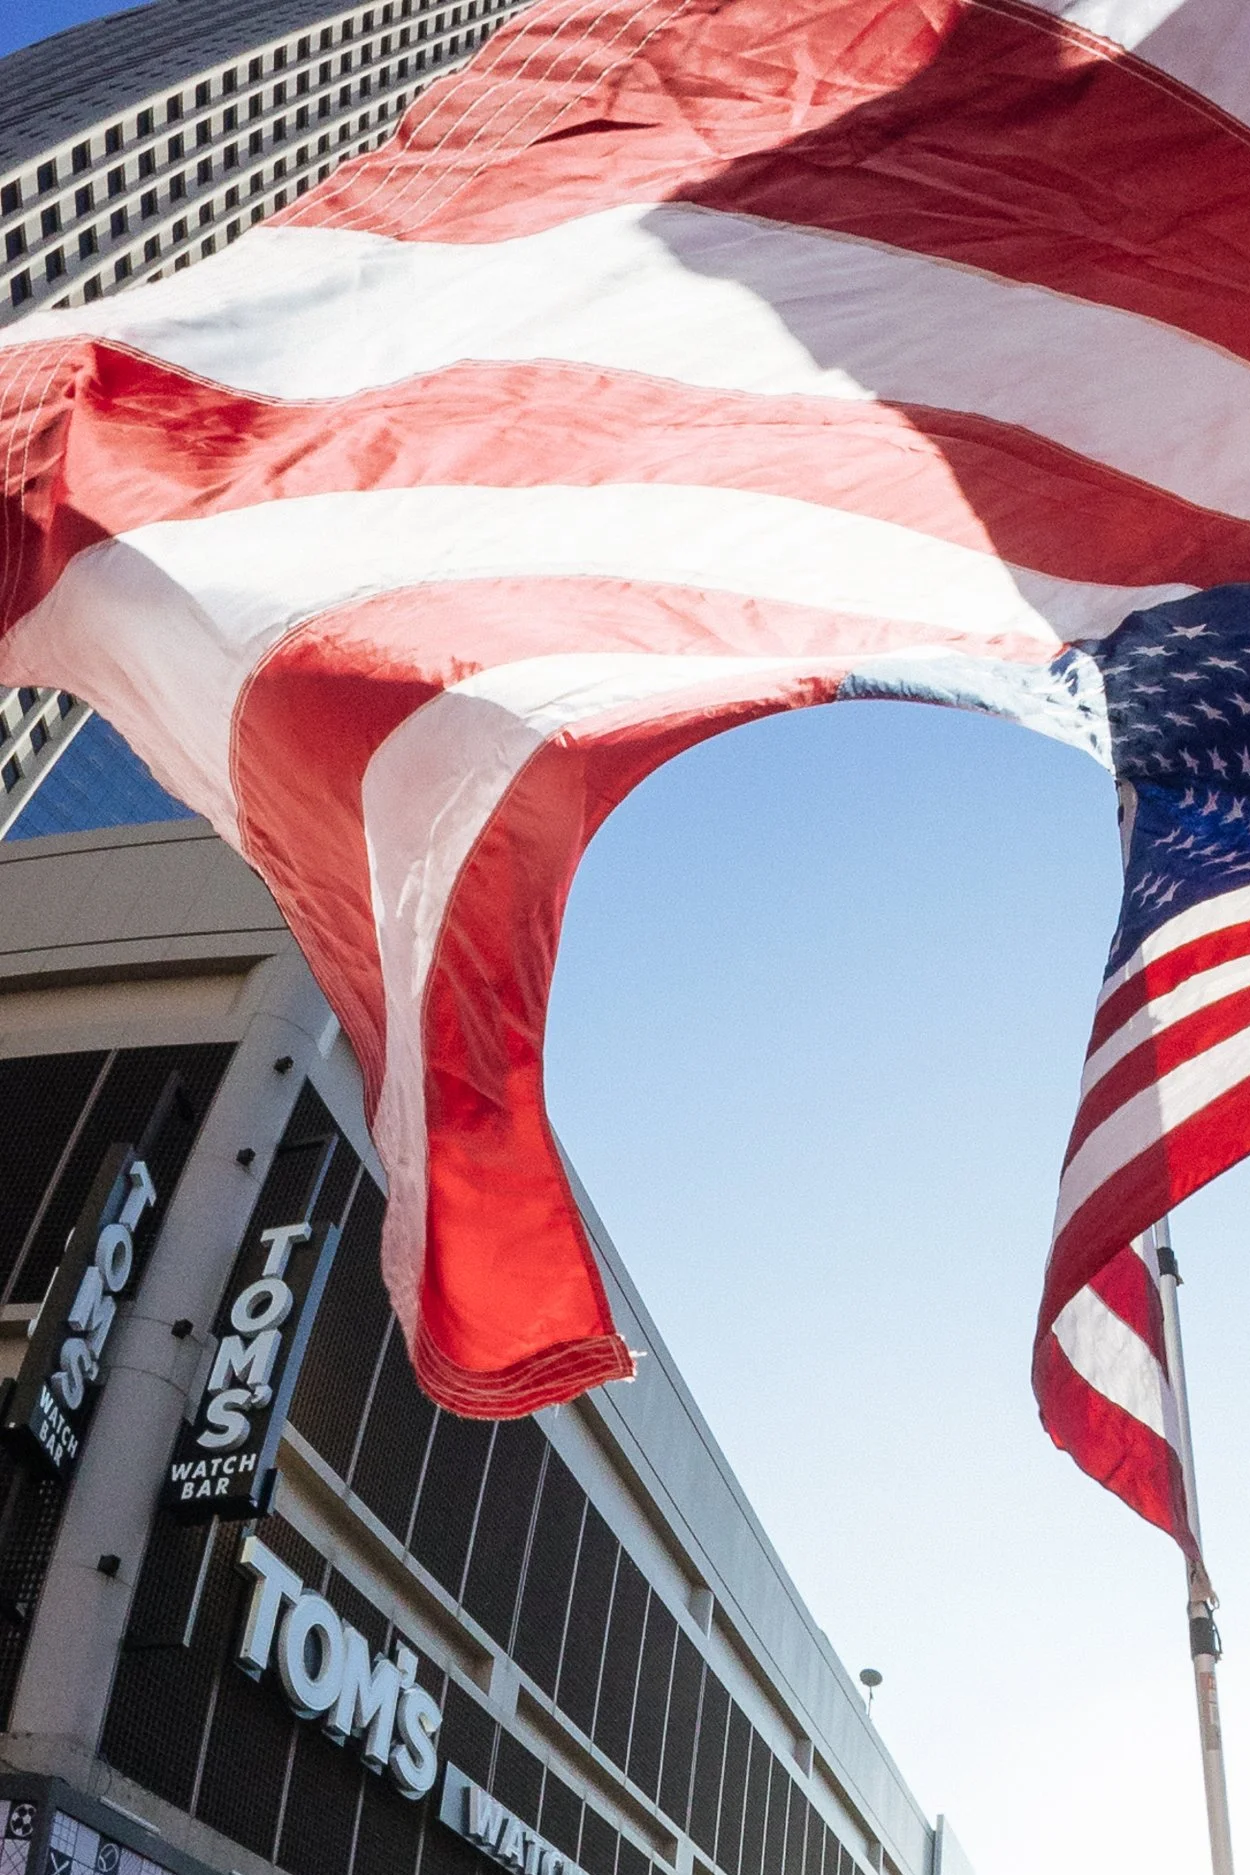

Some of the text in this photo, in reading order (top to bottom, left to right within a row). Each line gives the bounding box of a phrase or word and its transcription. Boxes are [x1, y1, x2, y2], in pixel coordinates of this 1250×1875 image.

[197, 1221, 312, 1452] TOM'S
[39, 1419, 64, 1467] BAR
[40, 1385, 78, 1459] WATCH
[170, 1452, 257, 1483] WATCH
[180, 1476, 231, 1501] BAR
[239, 1535, 443, 1797] TOM'S
